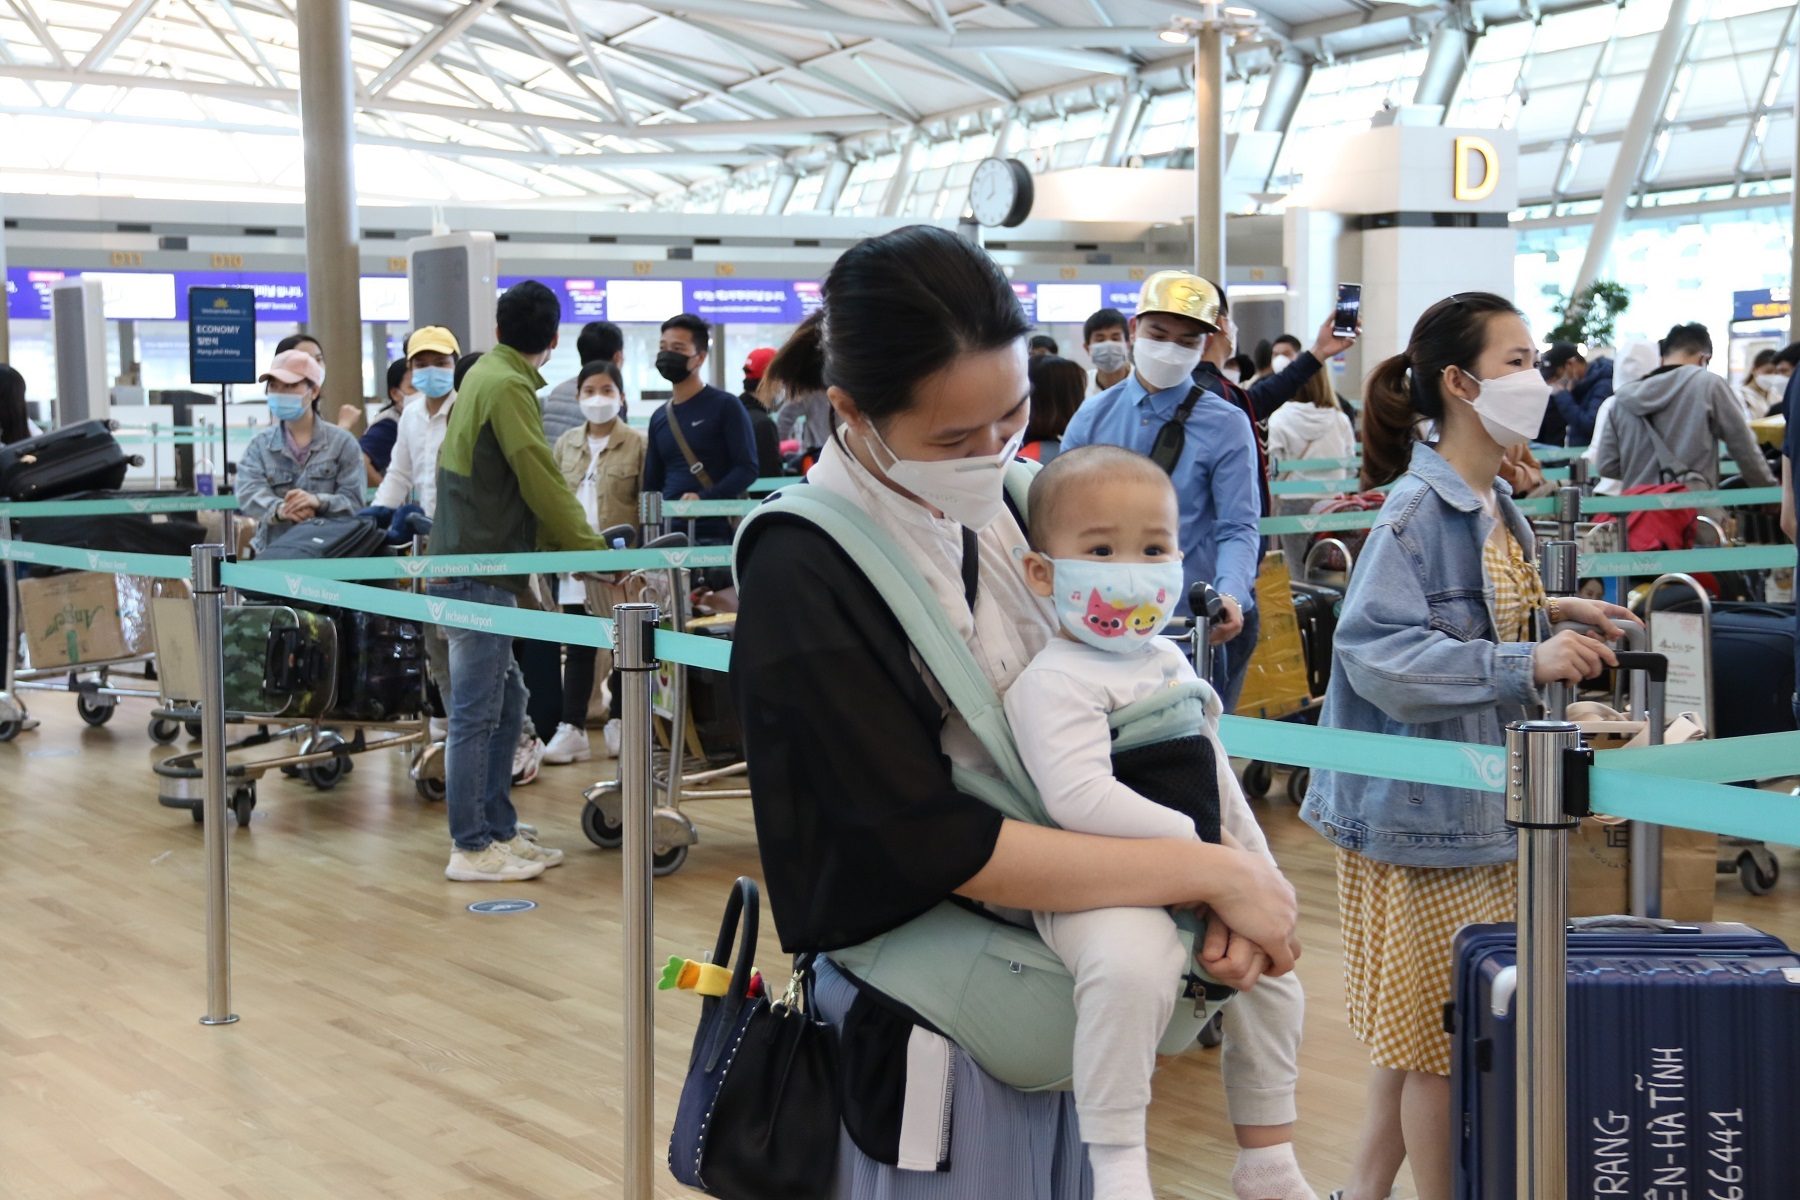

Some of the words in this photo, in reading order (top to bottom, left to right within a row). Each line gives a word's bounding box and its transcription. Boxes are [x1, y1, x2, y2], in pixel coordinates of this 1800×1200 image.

[1453, 136, 1500, 201] D
[196, 325, 240, 334] ECONOMY
[431, 564, 470, 574] Incheon
[473, 562, 508, 573] Airport
[445, 609, 469, 622] Incheon
[470, 613, 493, 627] Airport
[1634, 1047, 1686, 1110] TĨNH
